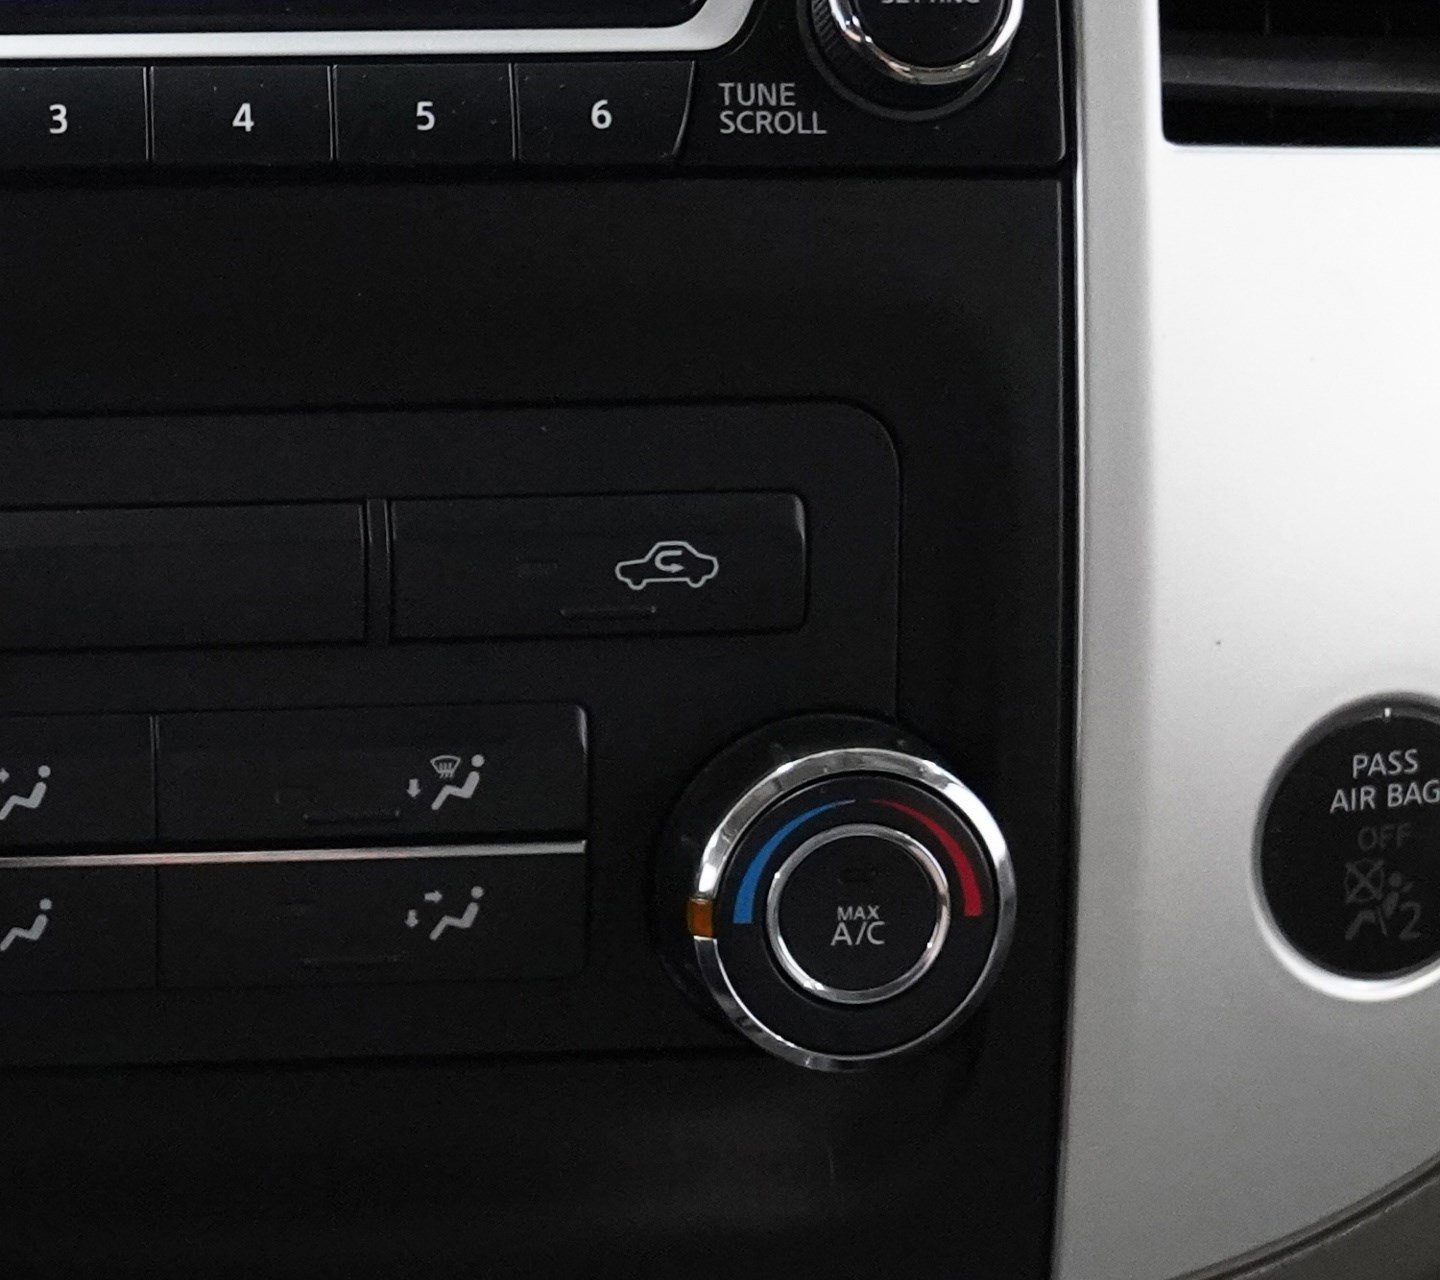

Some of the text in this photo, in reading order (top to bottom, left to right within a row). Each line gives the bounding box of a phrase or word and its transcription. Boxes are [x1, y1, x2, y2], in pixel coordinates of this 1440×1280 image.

[717, 82, 796, 107] TUNE
[49, 103, 68, 134] 3
[232, 102, 255, 132] 4
[416, 101, 435, 131] 5
[591, 99, 612, 129] 6
[719, 110, 827, 135] SCROLL
[1352, 748, 1419, 779] PASS
[1329, 779, 1440, 814] AIR BAG
[836, 905, 881, 921] MAX
[830, 922, 886, 946] A/C
